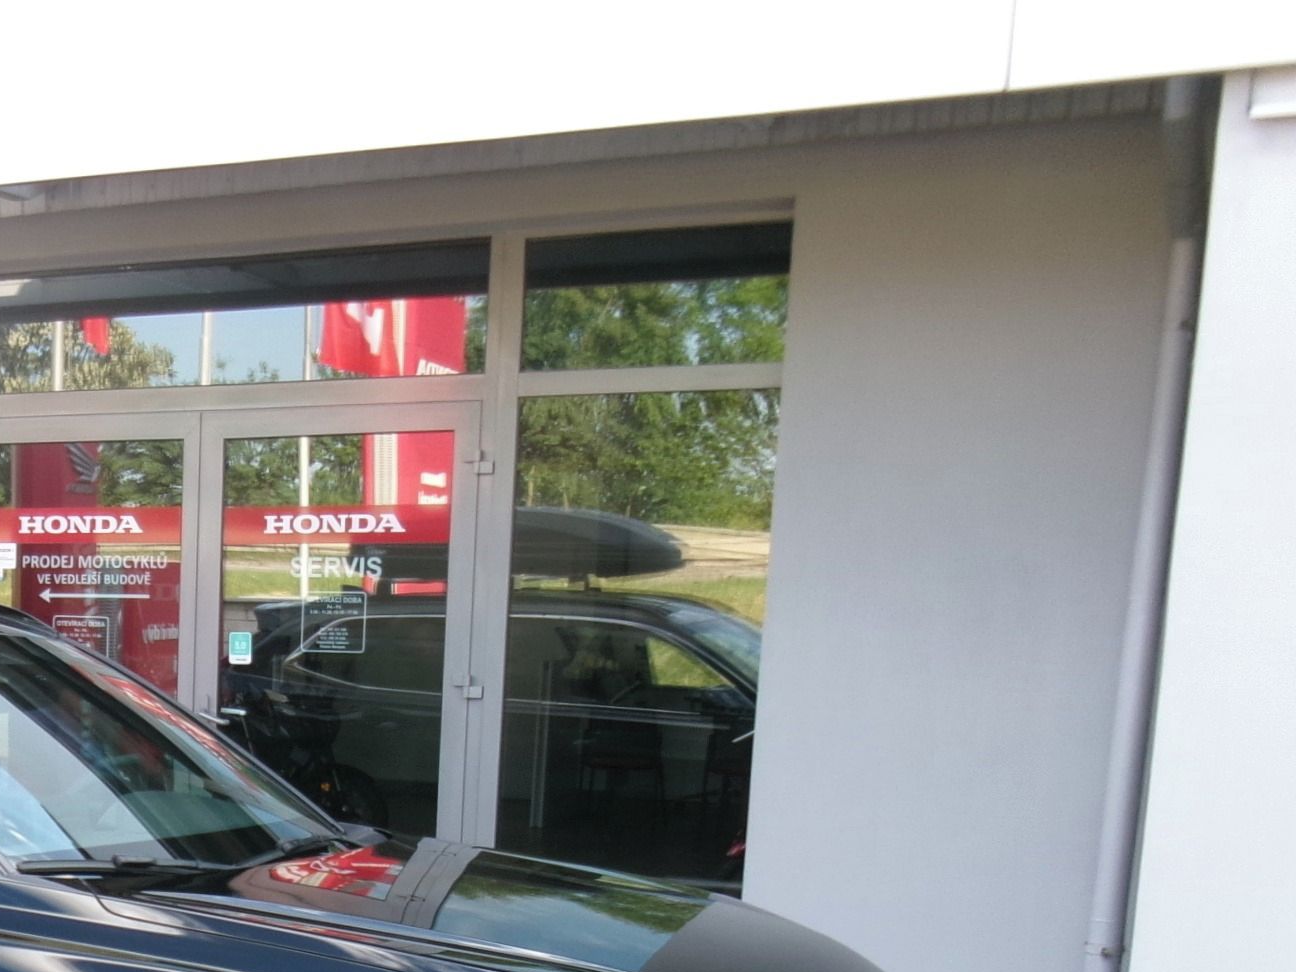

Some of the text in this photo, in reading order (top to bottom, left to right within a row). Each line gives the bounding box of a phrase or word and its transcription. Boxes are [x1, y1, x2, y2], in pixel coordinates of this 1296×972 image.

[18, 515, 144, 534] HONDA
[263, 513, 406, 534] HONDA
[22, 552, 168, 569] PRODEJ MOTOCYKLŮ
[290, 556, 383, 578] SERVIS
[37, 571, 151, 585] VE VEDLEJŠÍ BUDOVĚ
